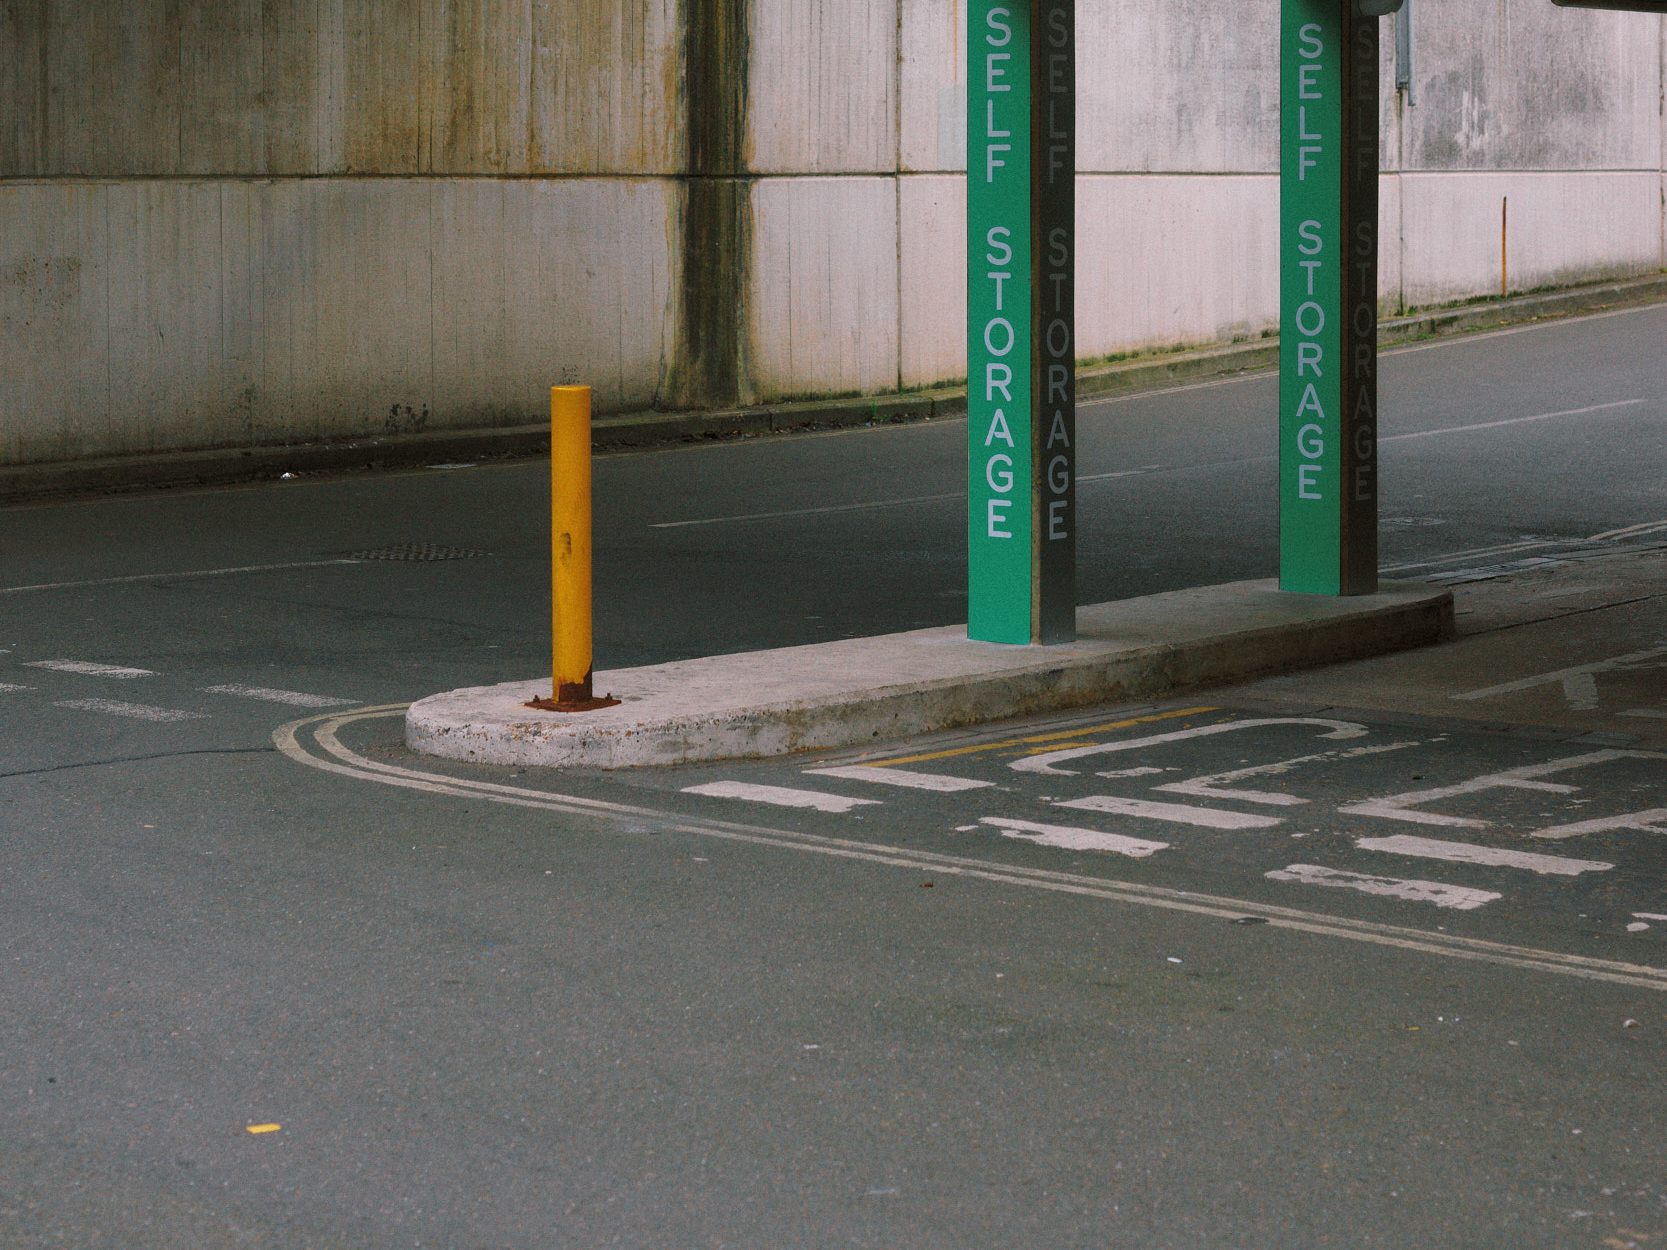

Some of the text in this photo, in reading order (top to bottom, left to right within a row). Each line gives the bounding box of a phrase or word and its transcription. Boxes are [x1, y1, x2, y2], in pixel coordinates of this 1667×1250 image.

[984, 7, 1015, 539] SELF STORAGE
[1046, 8, 1070, 541] SELF STORAGE
[1295, 23, 1325, 500] SELF STORAGE
[1353, 25, 1375, 501] SELF STORAGE
